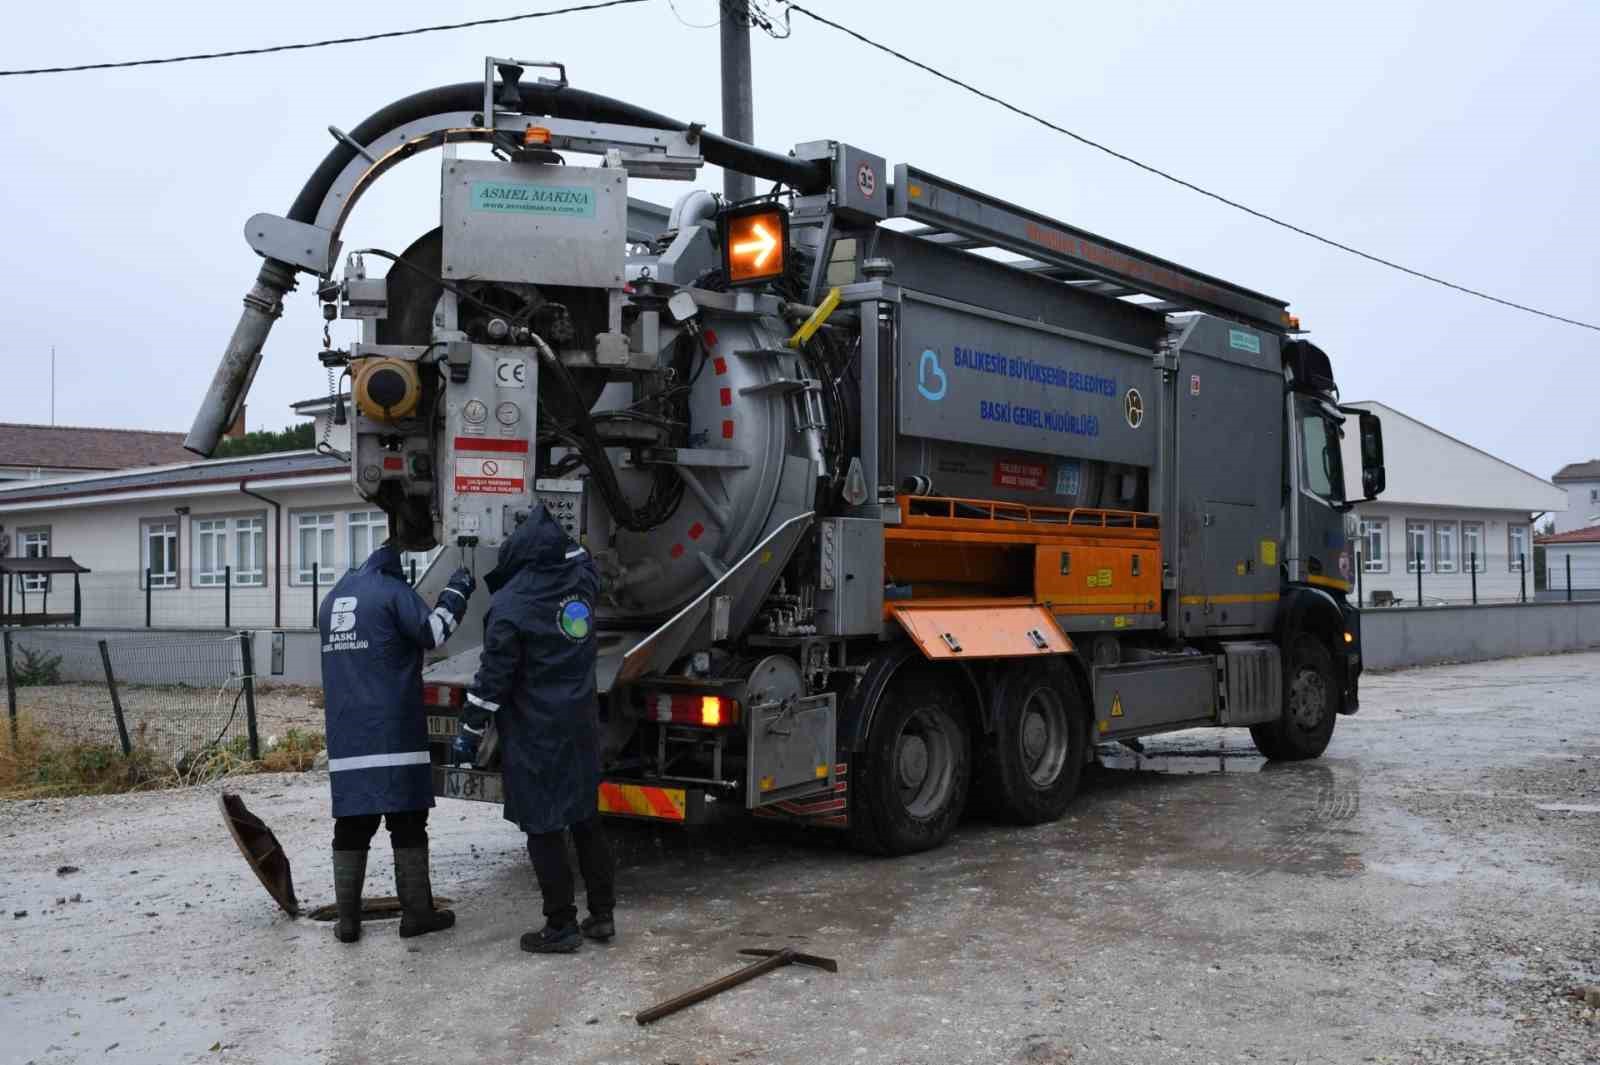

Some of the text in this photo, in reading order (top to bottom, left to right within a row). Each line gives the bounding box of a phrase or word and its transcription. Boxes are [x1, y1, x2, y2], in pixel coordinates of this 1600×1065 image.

[480, 187, 588, 204] ASMEL MAKİNA
[954, 347, 1007, 376] BALIKESİR
[497, 363, 525, 382] CE
[980, 400, 1012, 424] BASKİ
[1013, 405, 1043, 430] GENEL
[329, 630, 357, 643] BASKİ
